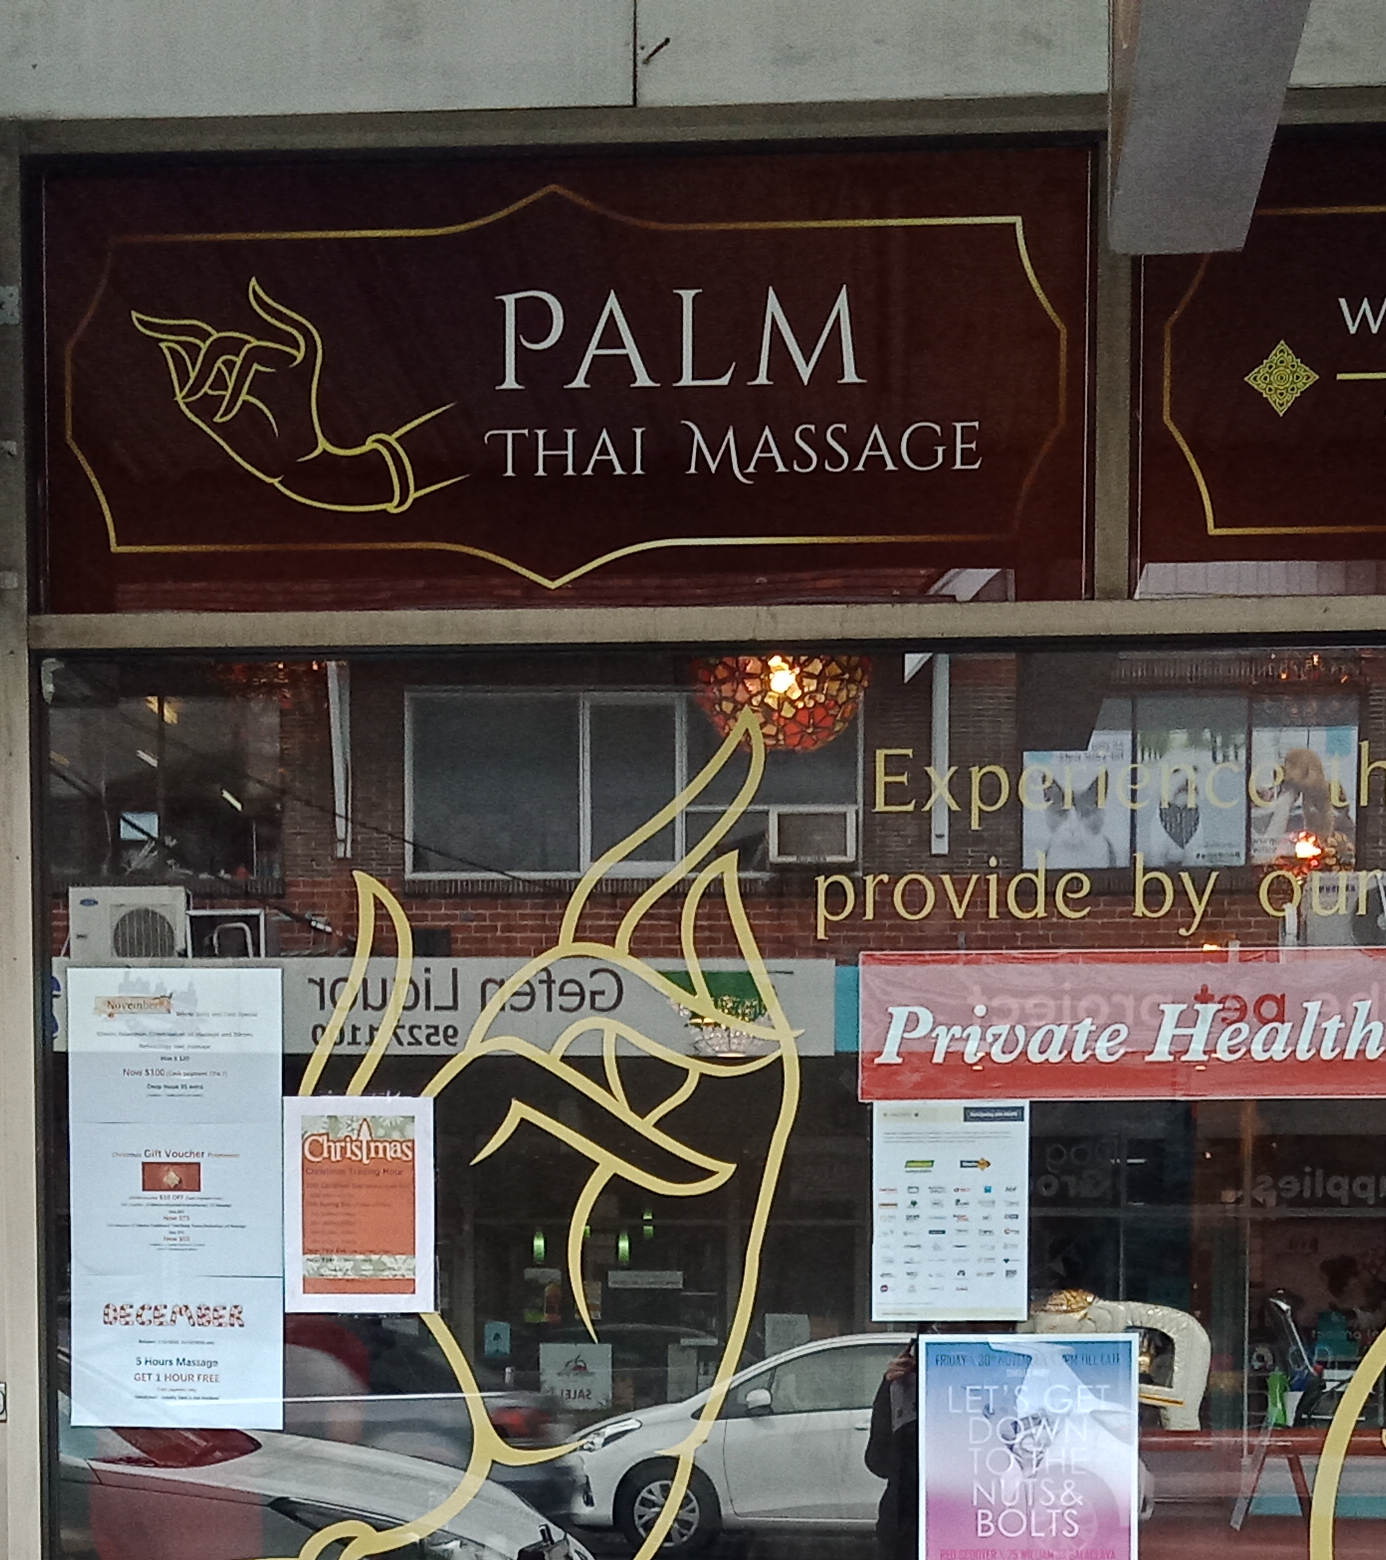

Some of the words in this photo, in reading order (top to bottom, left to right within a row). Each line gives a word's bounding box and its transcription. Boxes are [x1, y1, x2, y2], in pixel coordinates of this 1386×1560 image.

[494, 284, 868, 391] PALM
[484, 427, 645, 478] THAI
[680, 418, 982, 486] MASSAGE
[872, 746, 1286, 830] Experience
[815, 855, 1092, 940] provide
[1132, 852, 1220, 937] by
[1258, 870, 1384, 919] our
[107, 999, 167, 1011] November
[873, 1003, 1127, 1067] Private
[1145, 999, 1386, 1065] Health
[123, 1068, 143, 1077] Now
[144, 1149, 162, 1159] Gift
[164, 1149, 205, 1159] Voucher
[303, 1118, 414, 1164] Christmas
[103, 1303, 245, 1328] DECEMBER
[135, 1357, 142, 1366] 5
[145, 1357, 174, 1367] Hours
[176, 1357, 219, 1369] Massage
[935, 1354, 968, 1366] FRIDAY
[134, 1372, 152, 1382] GET
[156, 1373, 161, 1382] 1
[164, 1373, 195, 1383] HOUR
[197, 1374, 220, 1383] FREE
[947, 1383, 1031, 1414] LET'S
[1043, 1383, 1111, 1414] GET
[968, 1415, 1088, 1446] DOWN
[968, 1447, 1015, 1476] TO
[1030, 1447, 1088, 1475] THE
[975, 1508, 1081, 1538] BOLTS
